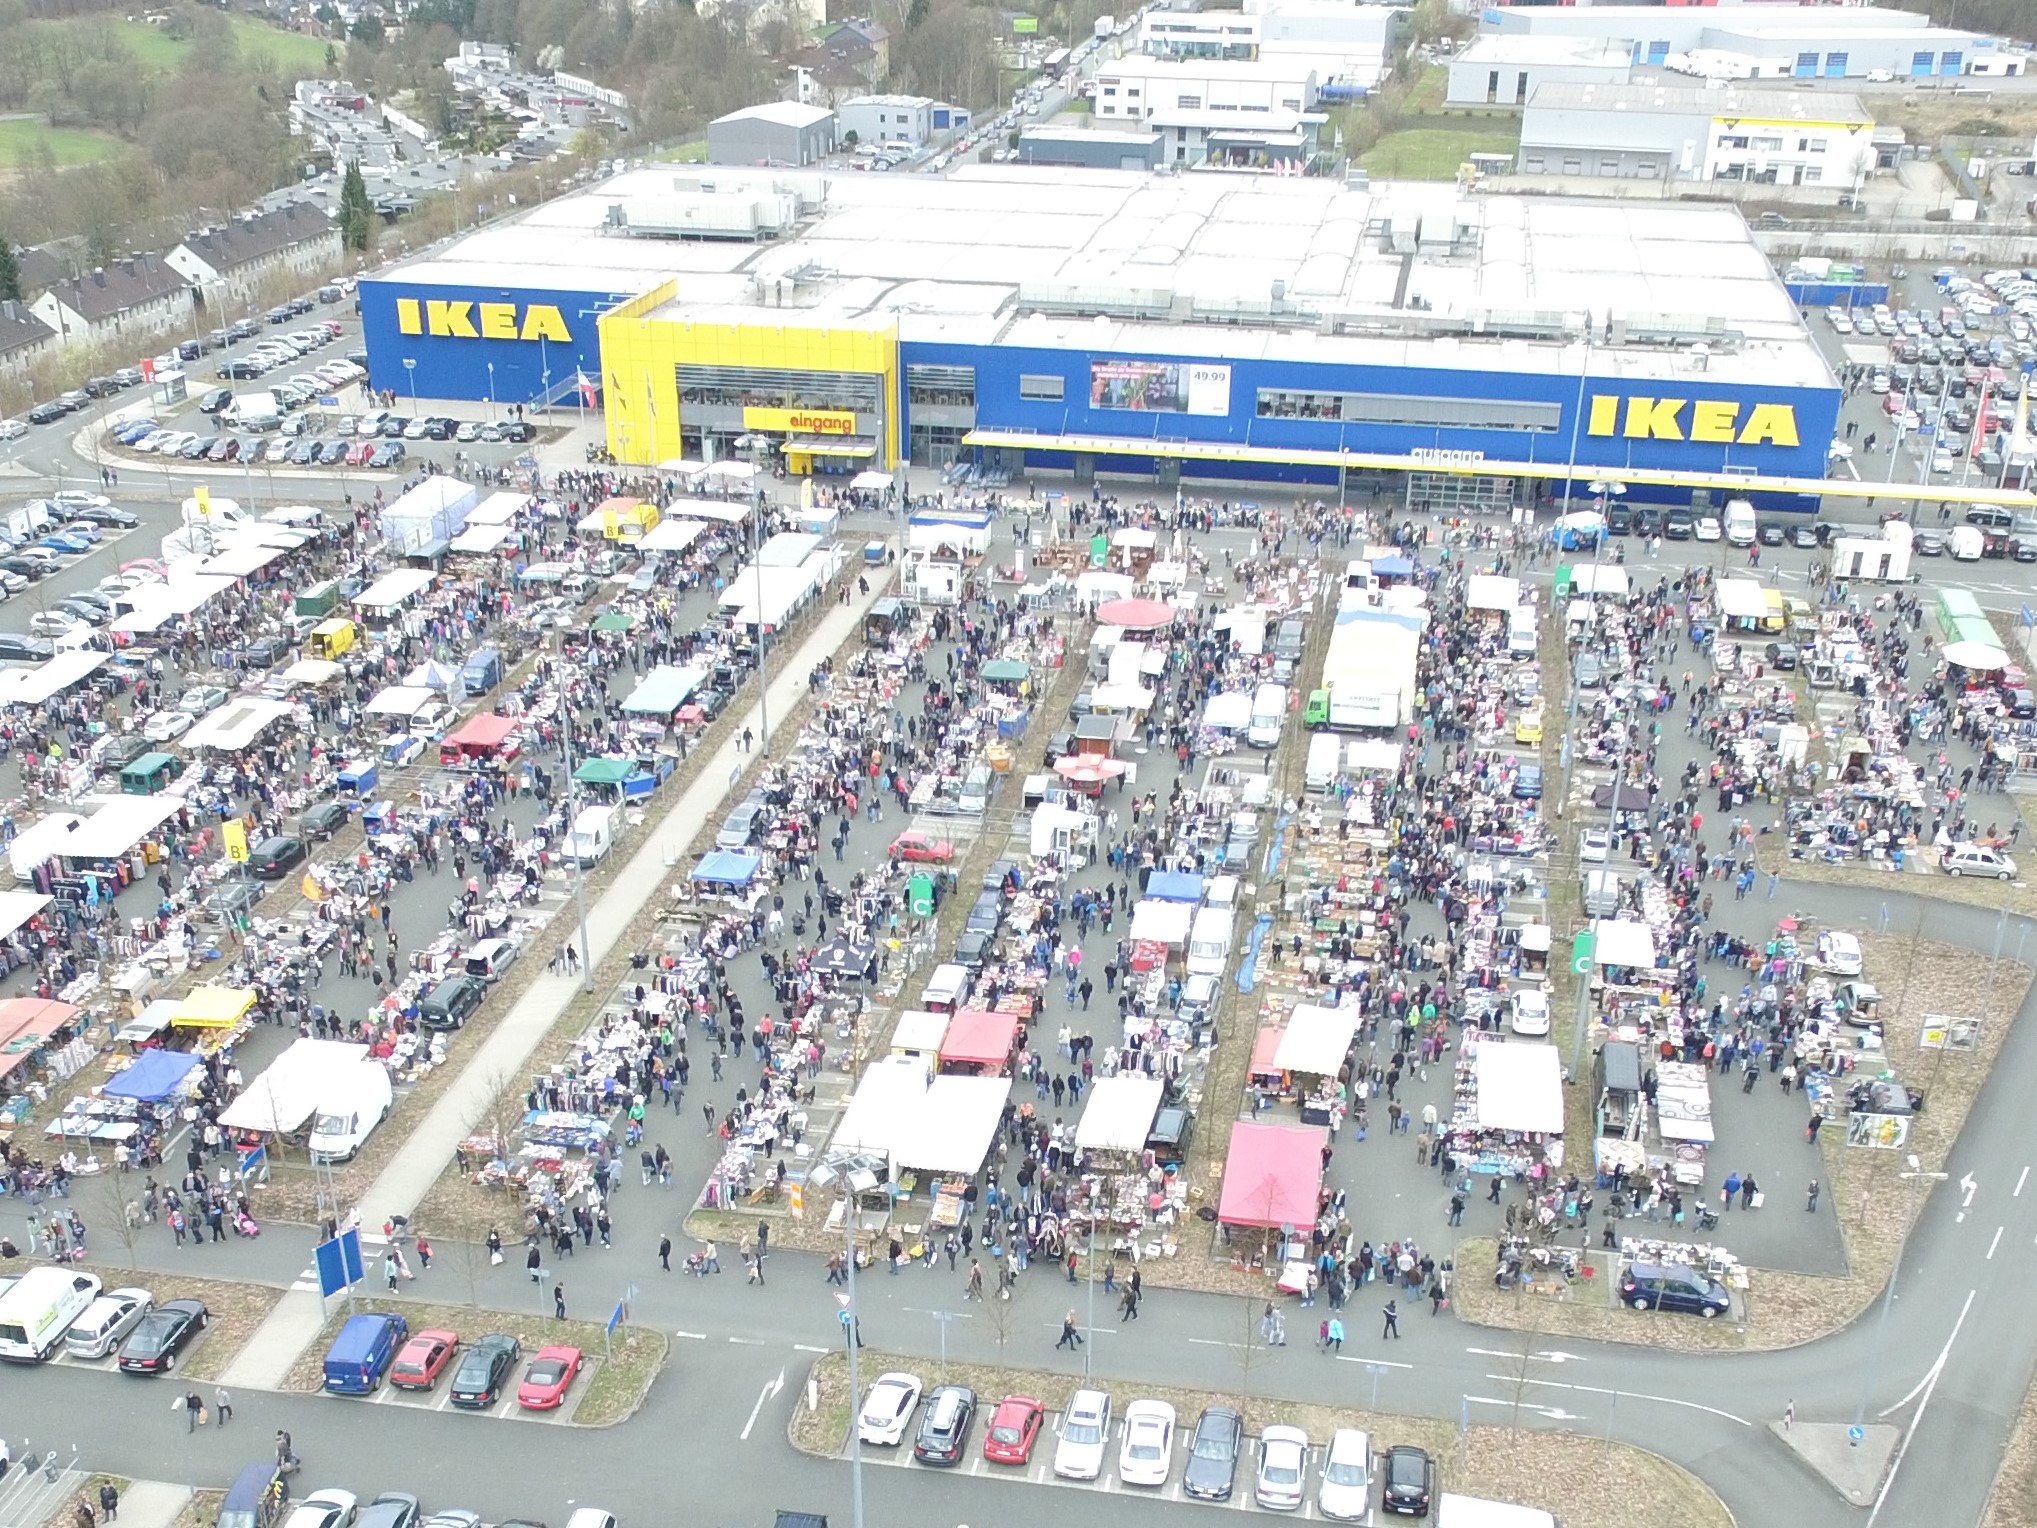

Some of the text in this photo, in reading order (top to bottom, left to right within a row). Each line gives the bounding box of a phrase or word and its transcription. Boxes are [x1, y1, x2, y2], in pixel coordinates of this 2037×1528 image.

[396, 298, 573, 342] IKEA
[1193, 371, 1226, 382] 49.99
[790, 412, 852, 434] eingang
[1586, 394, 1801, 447] IKEA
[199, 503, 207, 514] B
[606, 526, 614, 537] B
[1093, 553, 1105, 566] C
[1555, 582, 1569, 596] C
[230, 845, 241, 859] B
[913, 898, 930, 915] C
[1575, 956, 1590, 973] C
